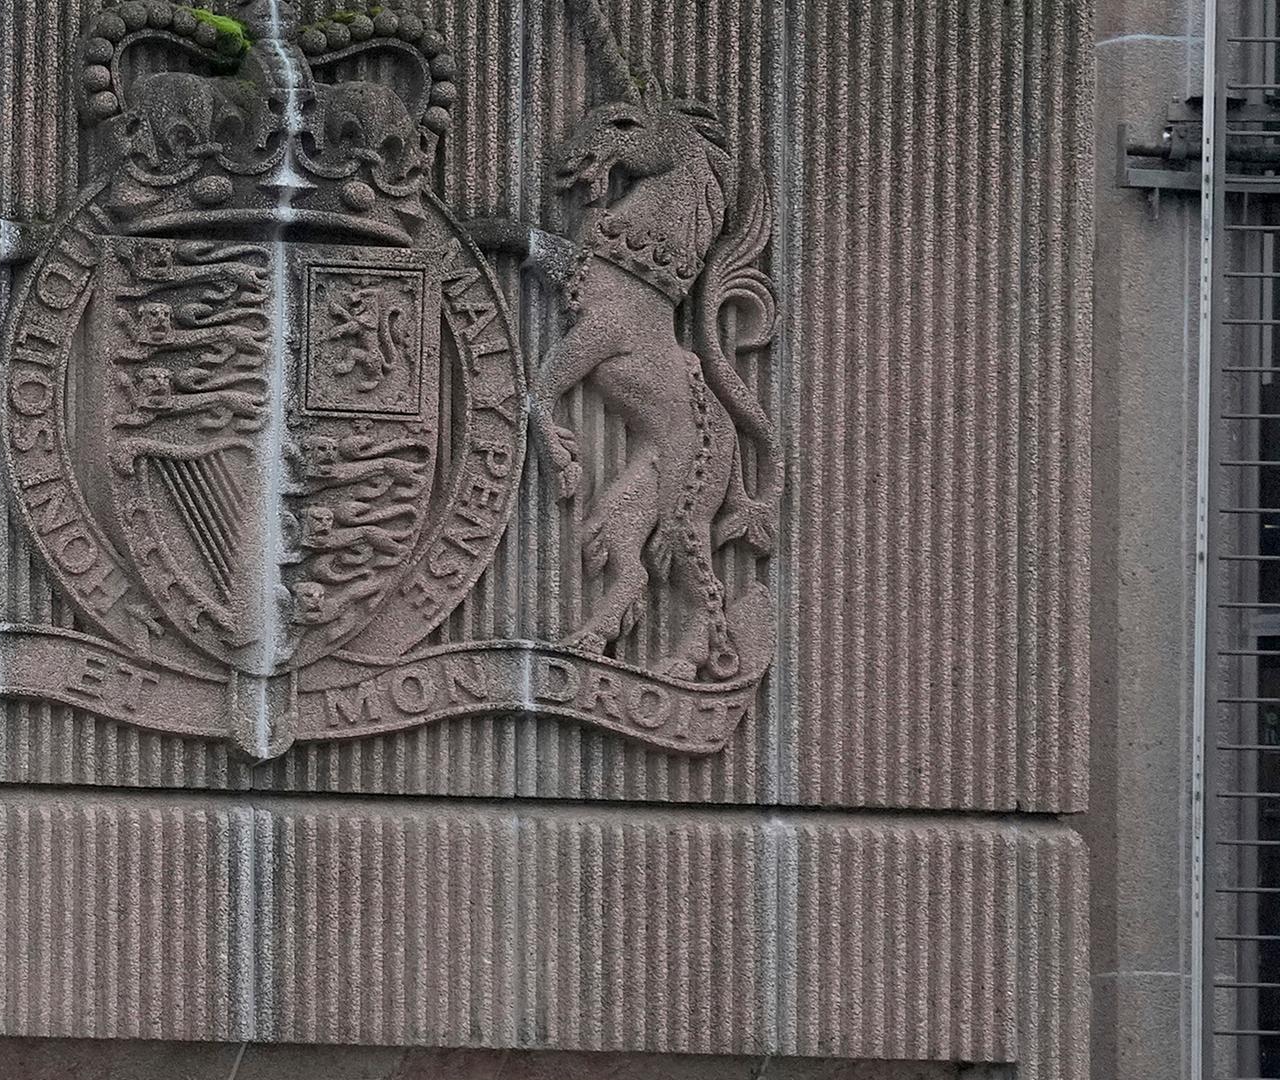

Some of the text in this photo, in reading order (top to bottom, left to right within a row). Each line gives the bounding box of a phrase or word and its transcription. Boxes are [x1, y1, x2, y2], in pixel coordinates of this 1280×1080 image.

[9, 308, 63, 451] SOIT
[469, 392, 517, 423] Y
[18, 468, 131, 615] HONI
[399, 440, 514, 619] PENSE
[65, 650, 161, 713] ET
[324, 655, 489, 728] MON
[533, 656, 741, 743] DROIT
